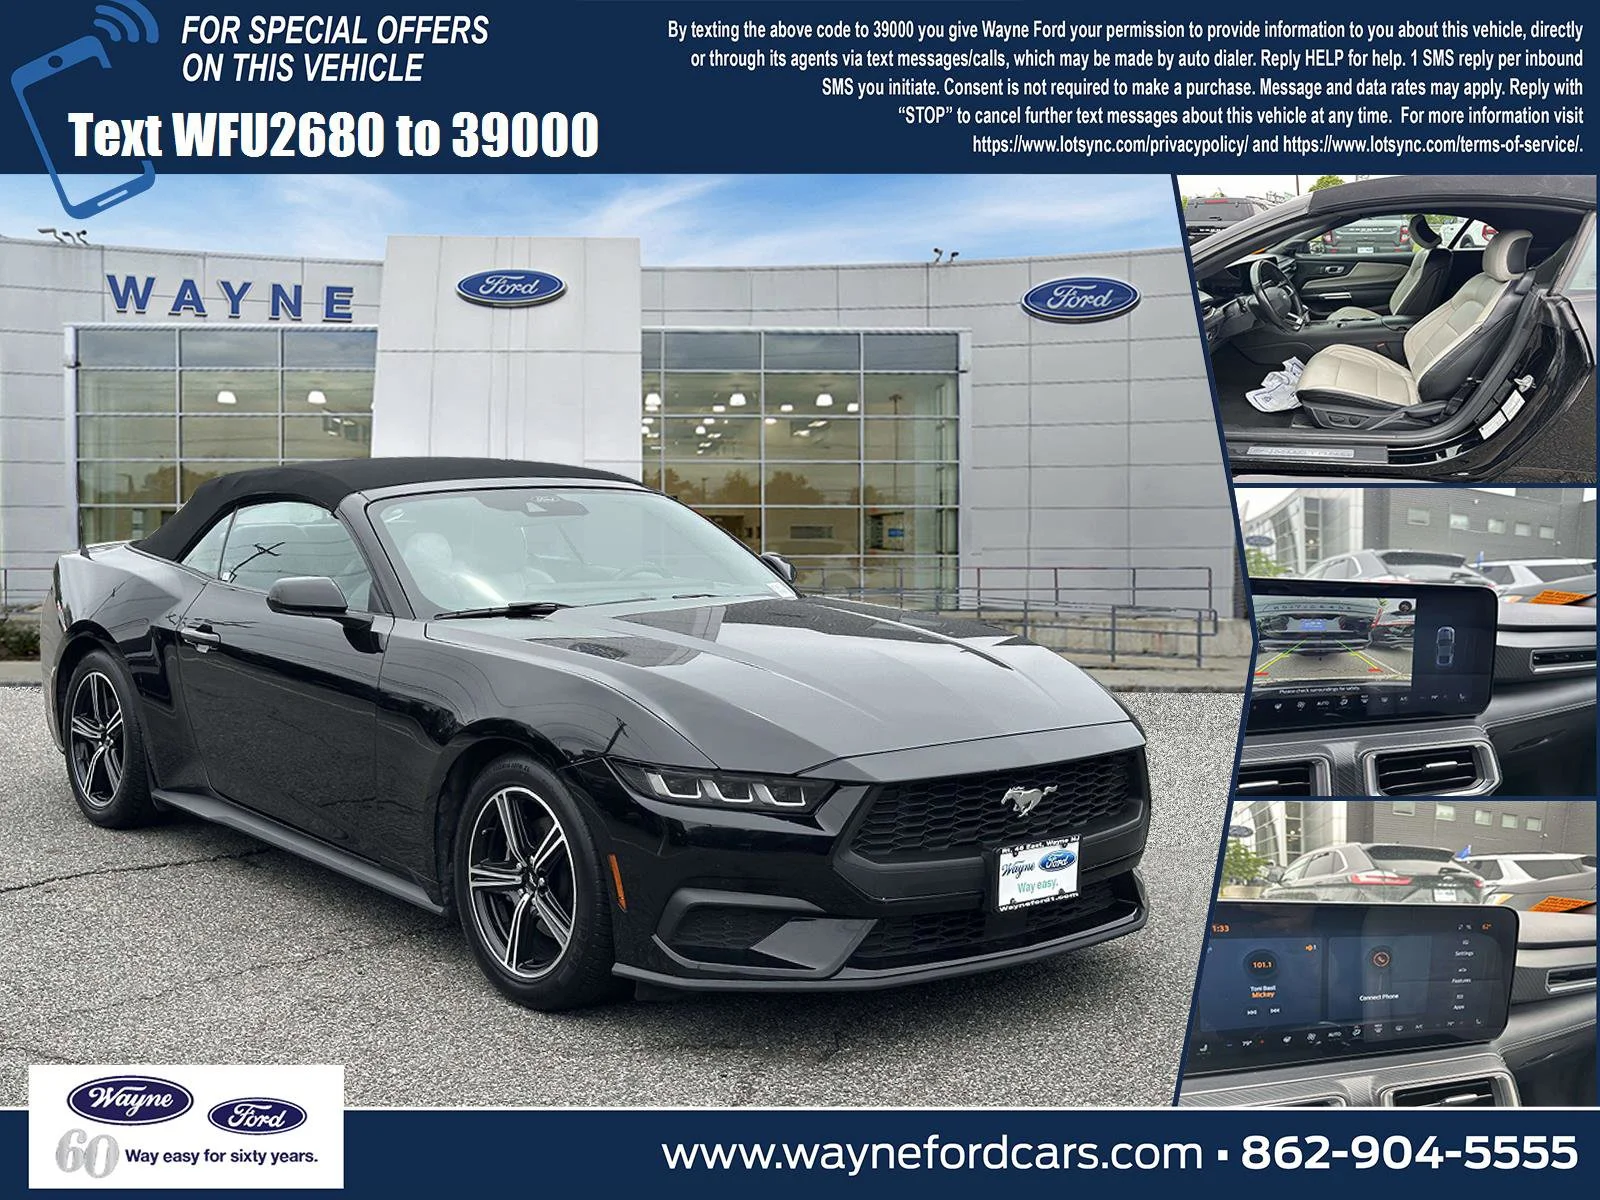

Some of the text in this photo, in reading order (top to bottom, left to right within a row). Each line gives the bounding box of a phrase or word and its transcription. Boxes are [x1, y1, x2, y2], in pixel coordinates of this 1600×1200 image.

[478, 272, 540, 297] Ford
[106, 273, 355, 322] WAYNE
[1046, 284, 1113, 310] Ford
[1001, 859, 1036, 879] Wayne
[1017, 878, 1059, 895] Way easy.
[1455, 950, 1475, 958] Settings
[1252, 961, 1273, 969] 101.1
[1359, 994, 1382, 1002] Connect
